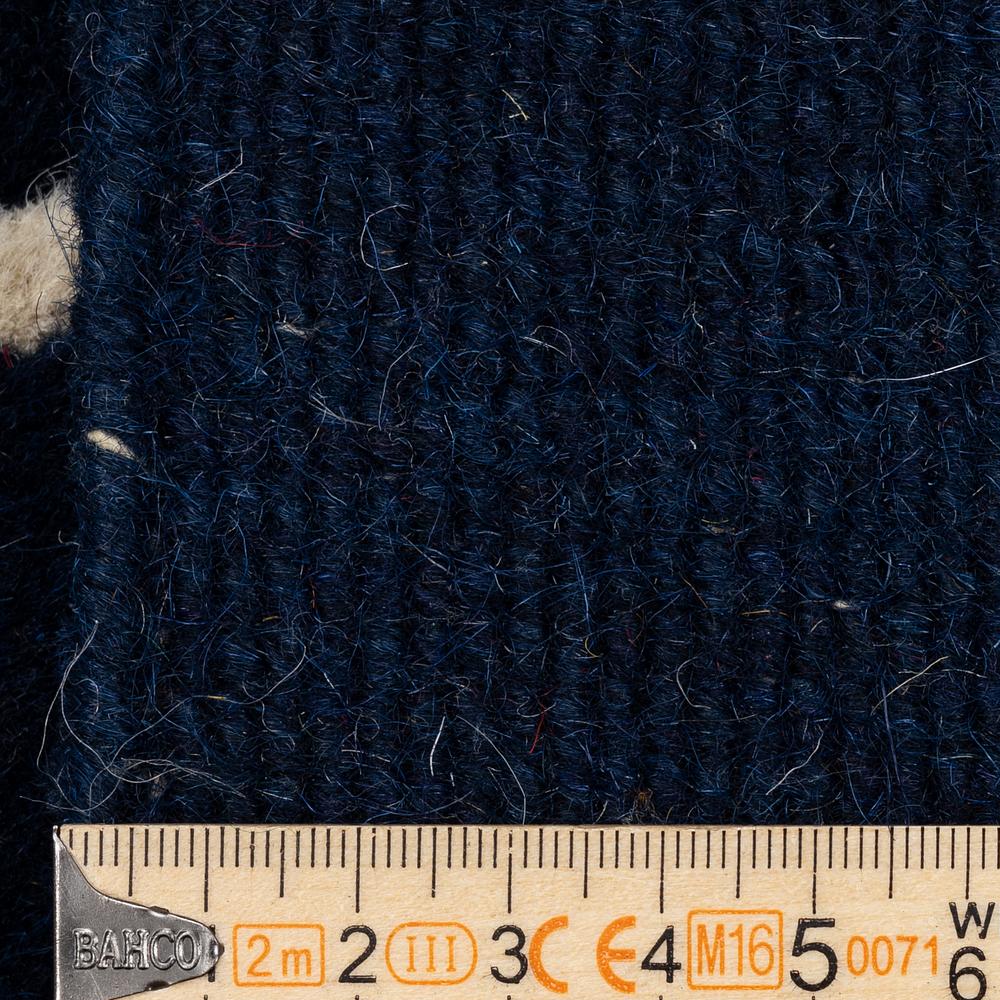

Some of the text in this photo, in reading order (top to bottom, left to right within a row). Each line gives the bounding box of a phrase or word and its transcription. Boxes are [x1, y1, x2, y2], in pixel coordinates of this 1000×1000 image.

[73, 927, 201, 970] BAHCO
[338, 925, 377, 983] 2
[406, 936, 457, 972] III
[490, 925, 529, 984] 3
[641, 925, 681, 983] 4
[697, 924, 774, 976] M16
[790, 917, 838, 992] 5
[847, 935, 938, 976] 0071
